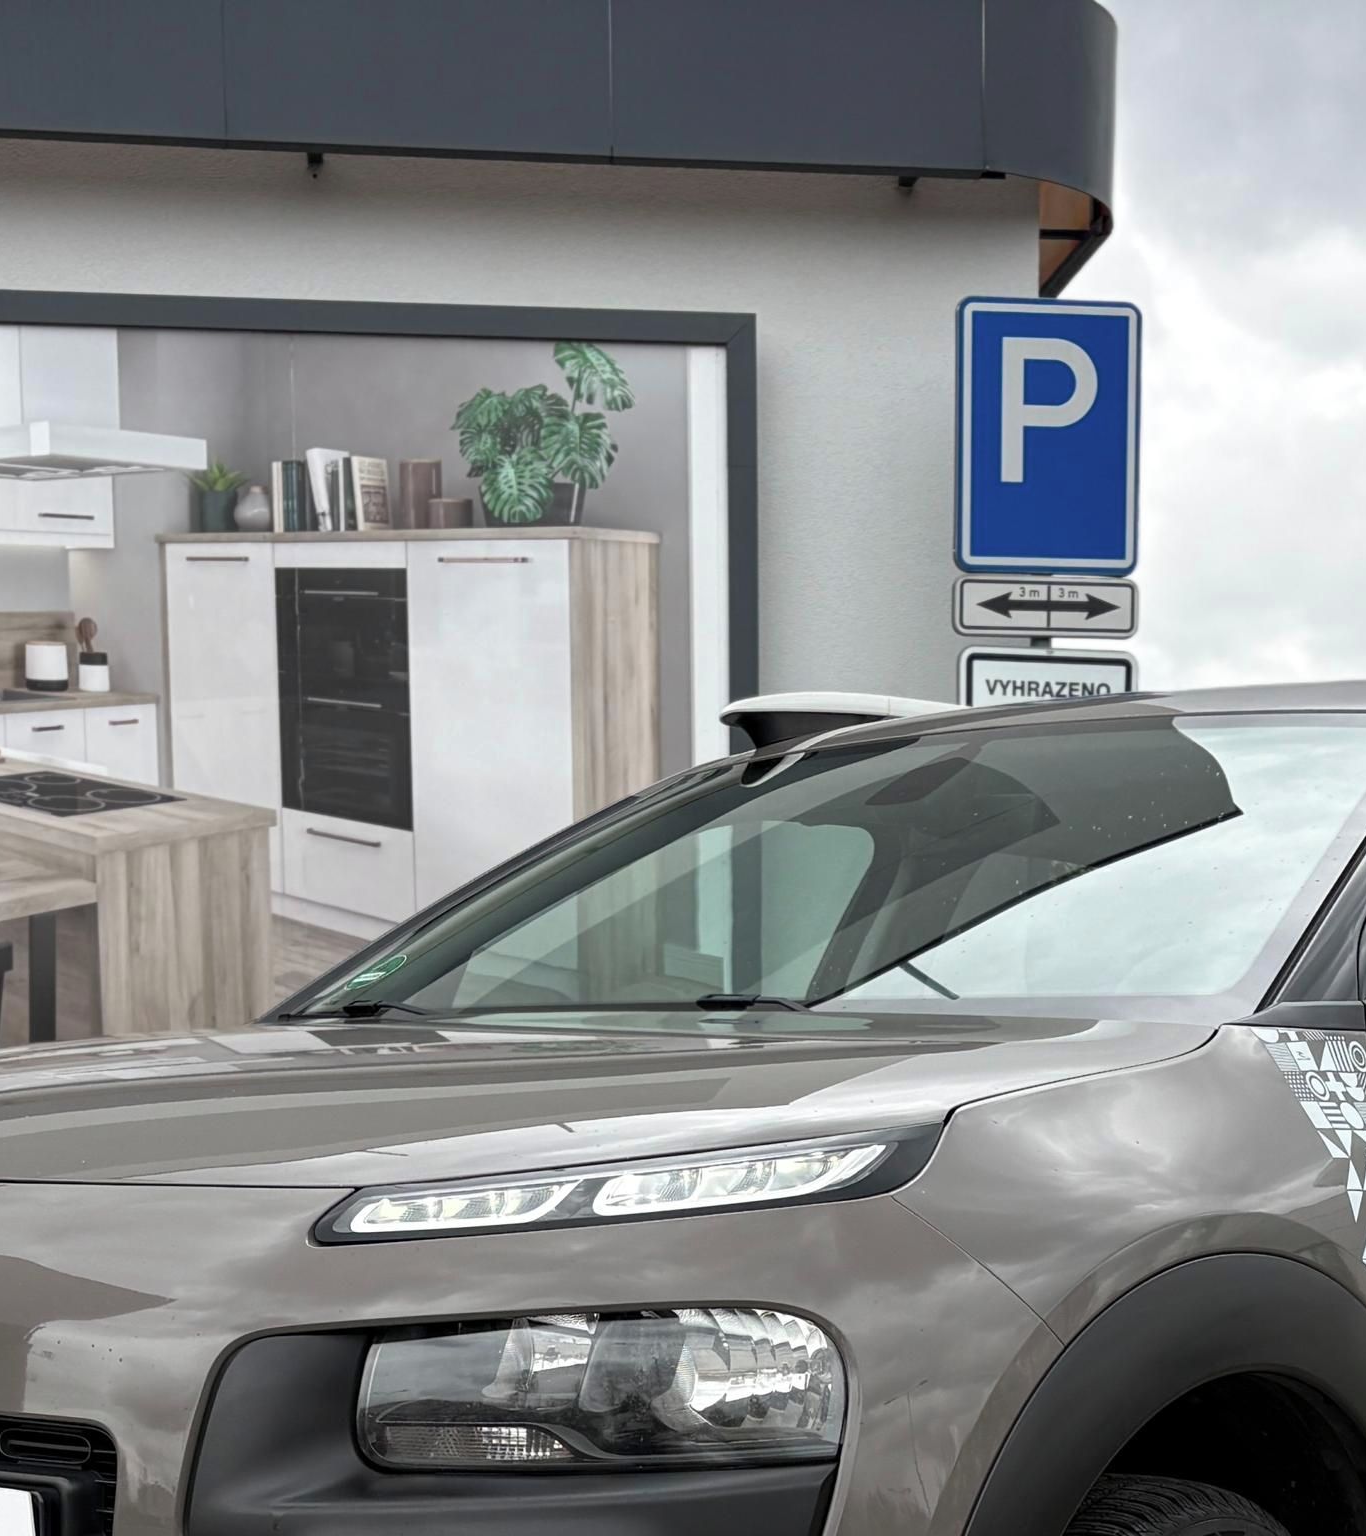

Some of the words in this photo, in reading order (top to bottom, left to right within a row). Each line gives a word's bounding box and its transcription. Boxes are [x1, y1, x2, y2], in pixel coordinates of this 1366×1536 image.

[1000, 336, 1098, 483] P
[1019, 586, 1026, 598] 3
[1029, 589, 1040, 598] m
[1058, 587, 1065, 599] 3
[1068, 590, 1079, 599] m
[985, 679, 1111, 699] VYHRAZENO
